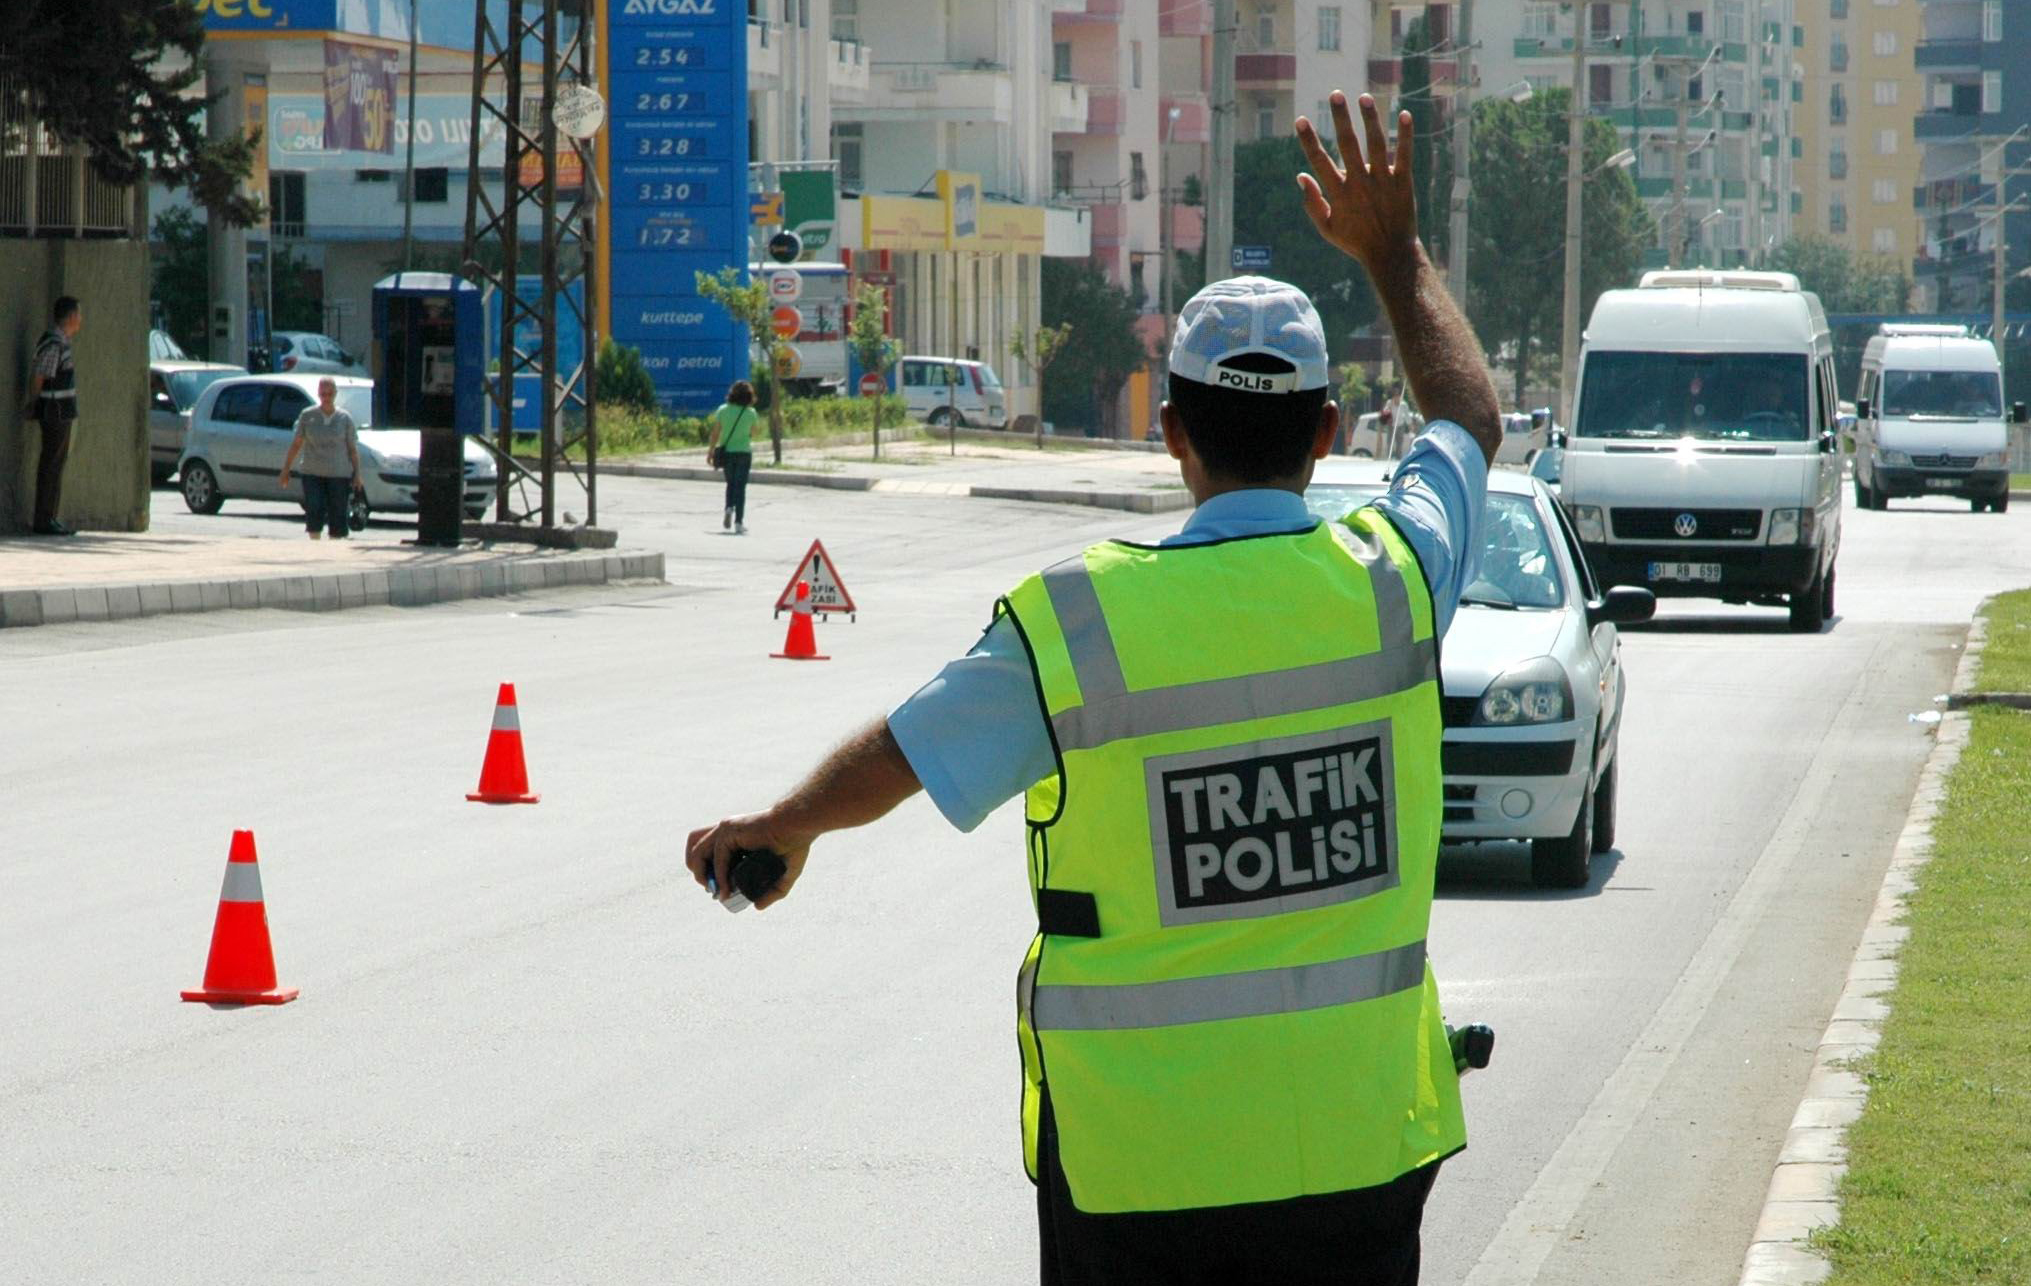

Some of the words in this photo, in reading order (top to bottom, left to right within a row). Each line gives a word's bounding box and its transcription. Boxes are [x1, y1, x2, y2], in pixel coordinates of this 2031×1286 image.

[636, 49, 688, 65] 2.54
[637, 94, 689, 110] 2.67
[639, 139, 689, 155] 3.28
[639, 184, 690, 200] 3.30
[641, 229, 690, 245] 1.72
[641, 312, 704, 325] kurttepe
[677, 356, 723, 370] petrol
